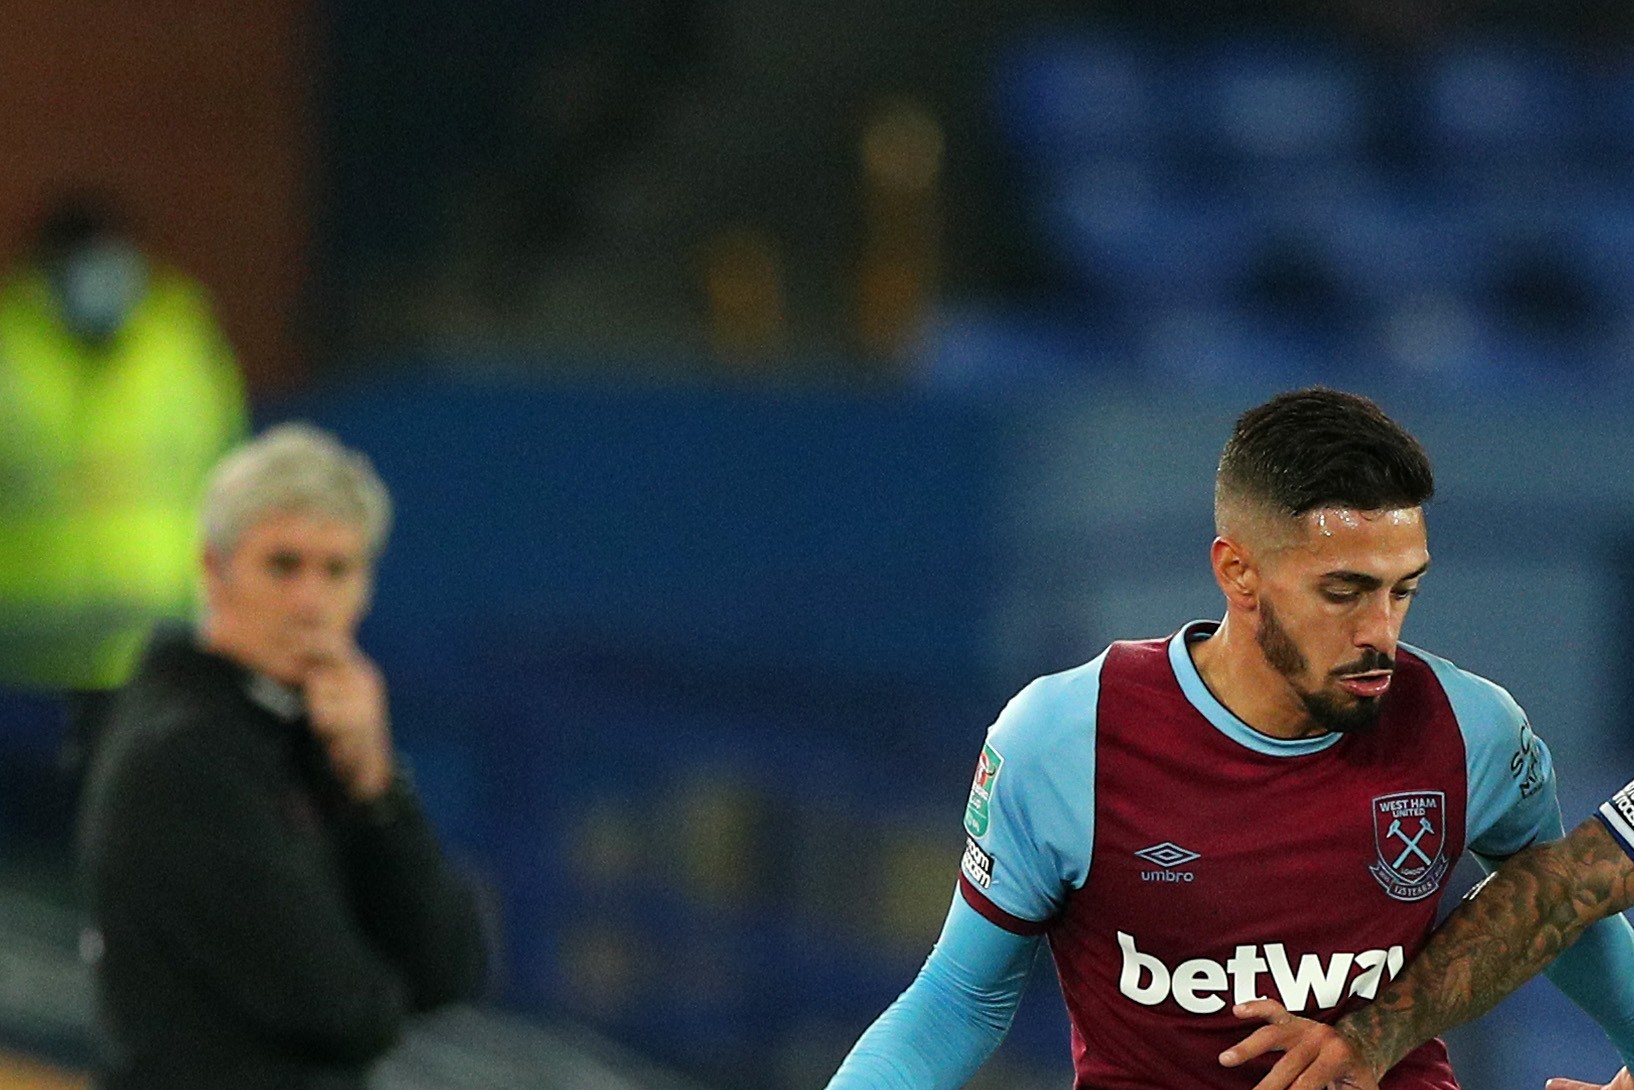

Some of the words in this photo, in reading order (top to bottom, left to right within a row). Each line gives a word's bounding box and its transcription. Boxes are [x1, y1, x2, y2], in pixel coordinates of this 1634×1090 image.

[1380, 799, 1409, 812] WEST
[1411, 797, 1437, 809] HAM
[1392, 808, 1426, 818] UNITED
[1141, 869, 1195, 882] umbro
[1116, 930, 1404, 1014] betwa
